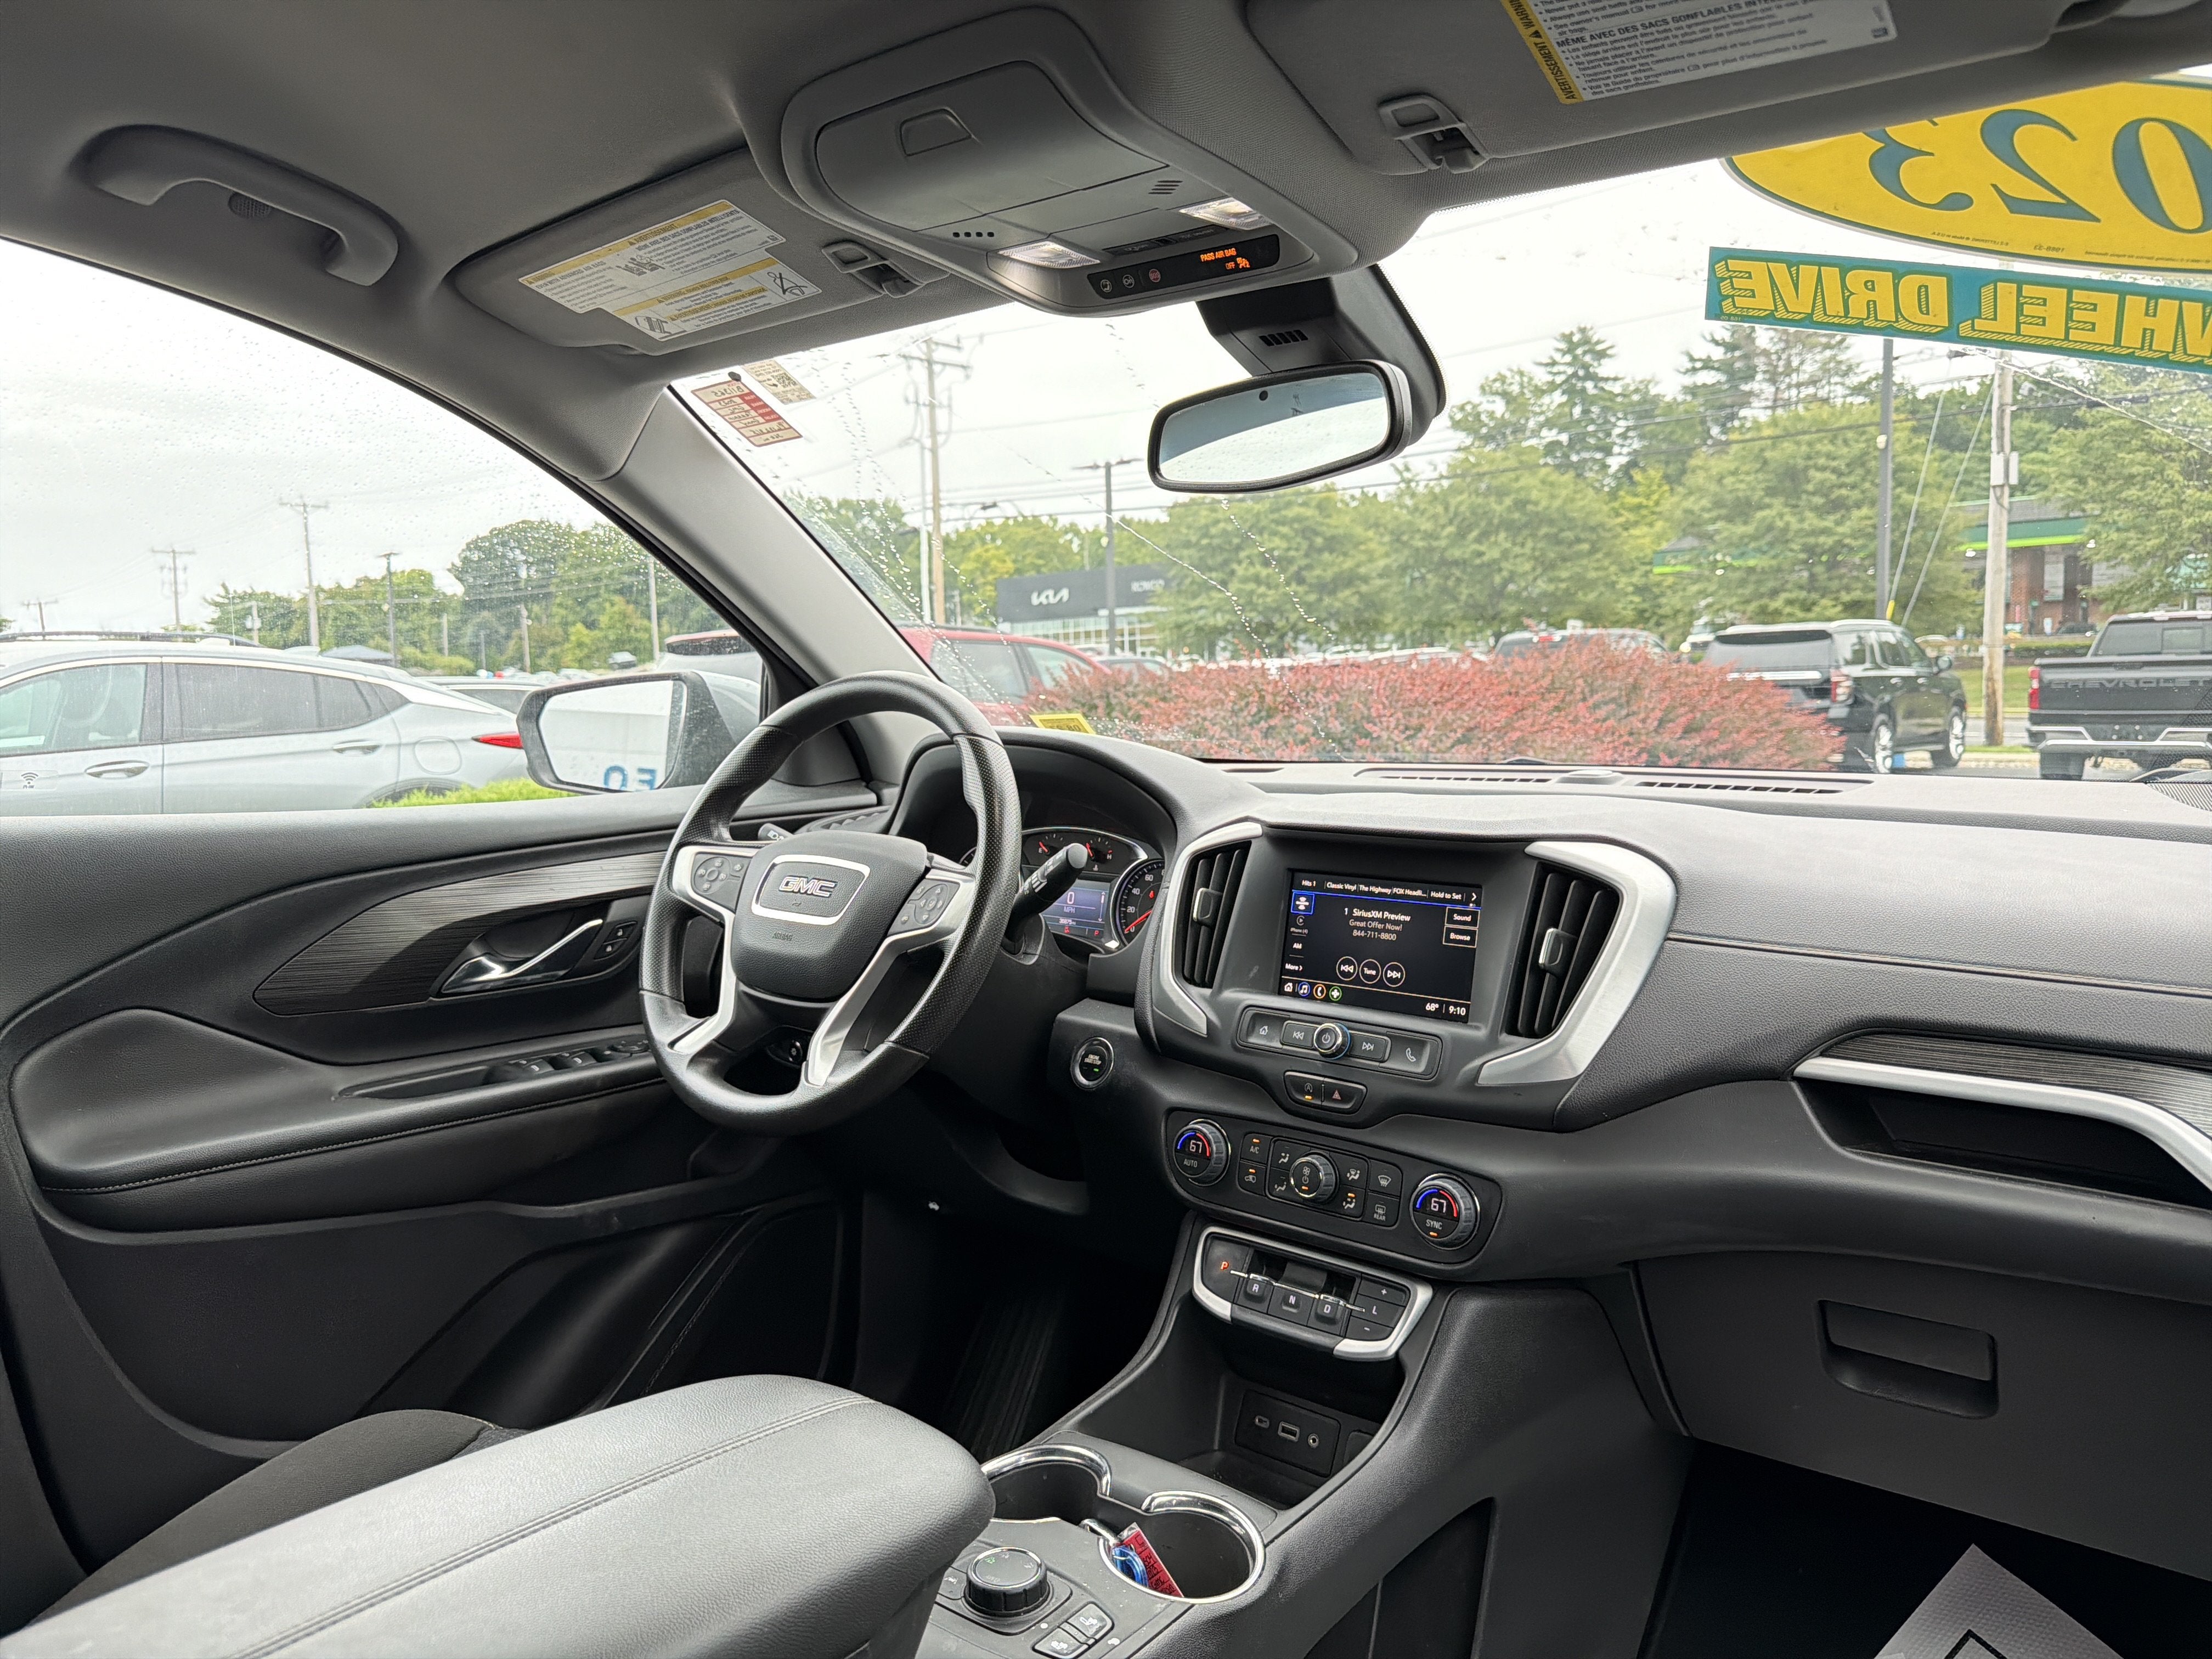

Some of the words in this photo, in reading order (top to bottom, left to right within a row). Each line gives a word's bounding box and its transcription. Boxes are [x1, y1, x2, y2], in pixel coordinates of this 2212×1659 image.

[1556, 36, 1588, 48] MÊME
[1589, 30, 1616, 42] AVEC
[1618, 25, 1639, 35] DES
[1640, 18, 1669, 30] SACS
[1672, 3, 1742, 24] GONFLABLES
[1533, 42, 1577, 99] AVERTISSEMENT
[1200, 252, 1215, 262] PASS
[1216, 250, 1225, 259] AIR
[1225, 247, 1237, 257] BAG
[1225, 262, 1235, 270] OFF
[1030, 587, 1069, 606] KIA
[2051, 678, 2212, 689] CHEVROLET
[778, 875, 838, 898] GMC
[1369, 885, 1392, 894] Highway
[1405, 888, 1426, 896] Headli...
[1066, 891, 1075, 905] 0
[1345, 907, 1348, 916] 1
[1352, 908, 1383, 919] SiriusXM
[1384, 911, 1411, 922] Preview
[1453, 913, 1472, 922] Sound
[1349, 919, 1367, 928] Great
[1367, 921, 1384, 929] Offer
[1386, 922, 1403, 931] Now!
[772, 932, 793, 941] AIRBAG
[1352, 929, 1397, 941] 844-711-8800
[1449, 933, 1471, 941] Browse
[1285, 963, 1299, 971] More
[1363, 967, 1376, 975] Tune
[1426, 1002, 1439, 1011] 68°
[1448, 1006, 1467, 1015] 9:10
[1189, 1140, 1203, 1154] 67
[1250, 1145, 1260, 1155] A/C
[1183, 1158, 1198, 1169] AUTO
[1431, 1198, 1447, 1212] 67
[1374, 1212, 1386, 1222] REAR
[1426, 1219, 1443, 1231] SYNC
[1220, 1261, 1229, 1271] P
[1252, 1284, 1260, 1293] R
[1289, 1295, 1296, 1305] N
[1323, 1305, 1331, 1314] D
[1372, 1306, 1378, 1315] L
